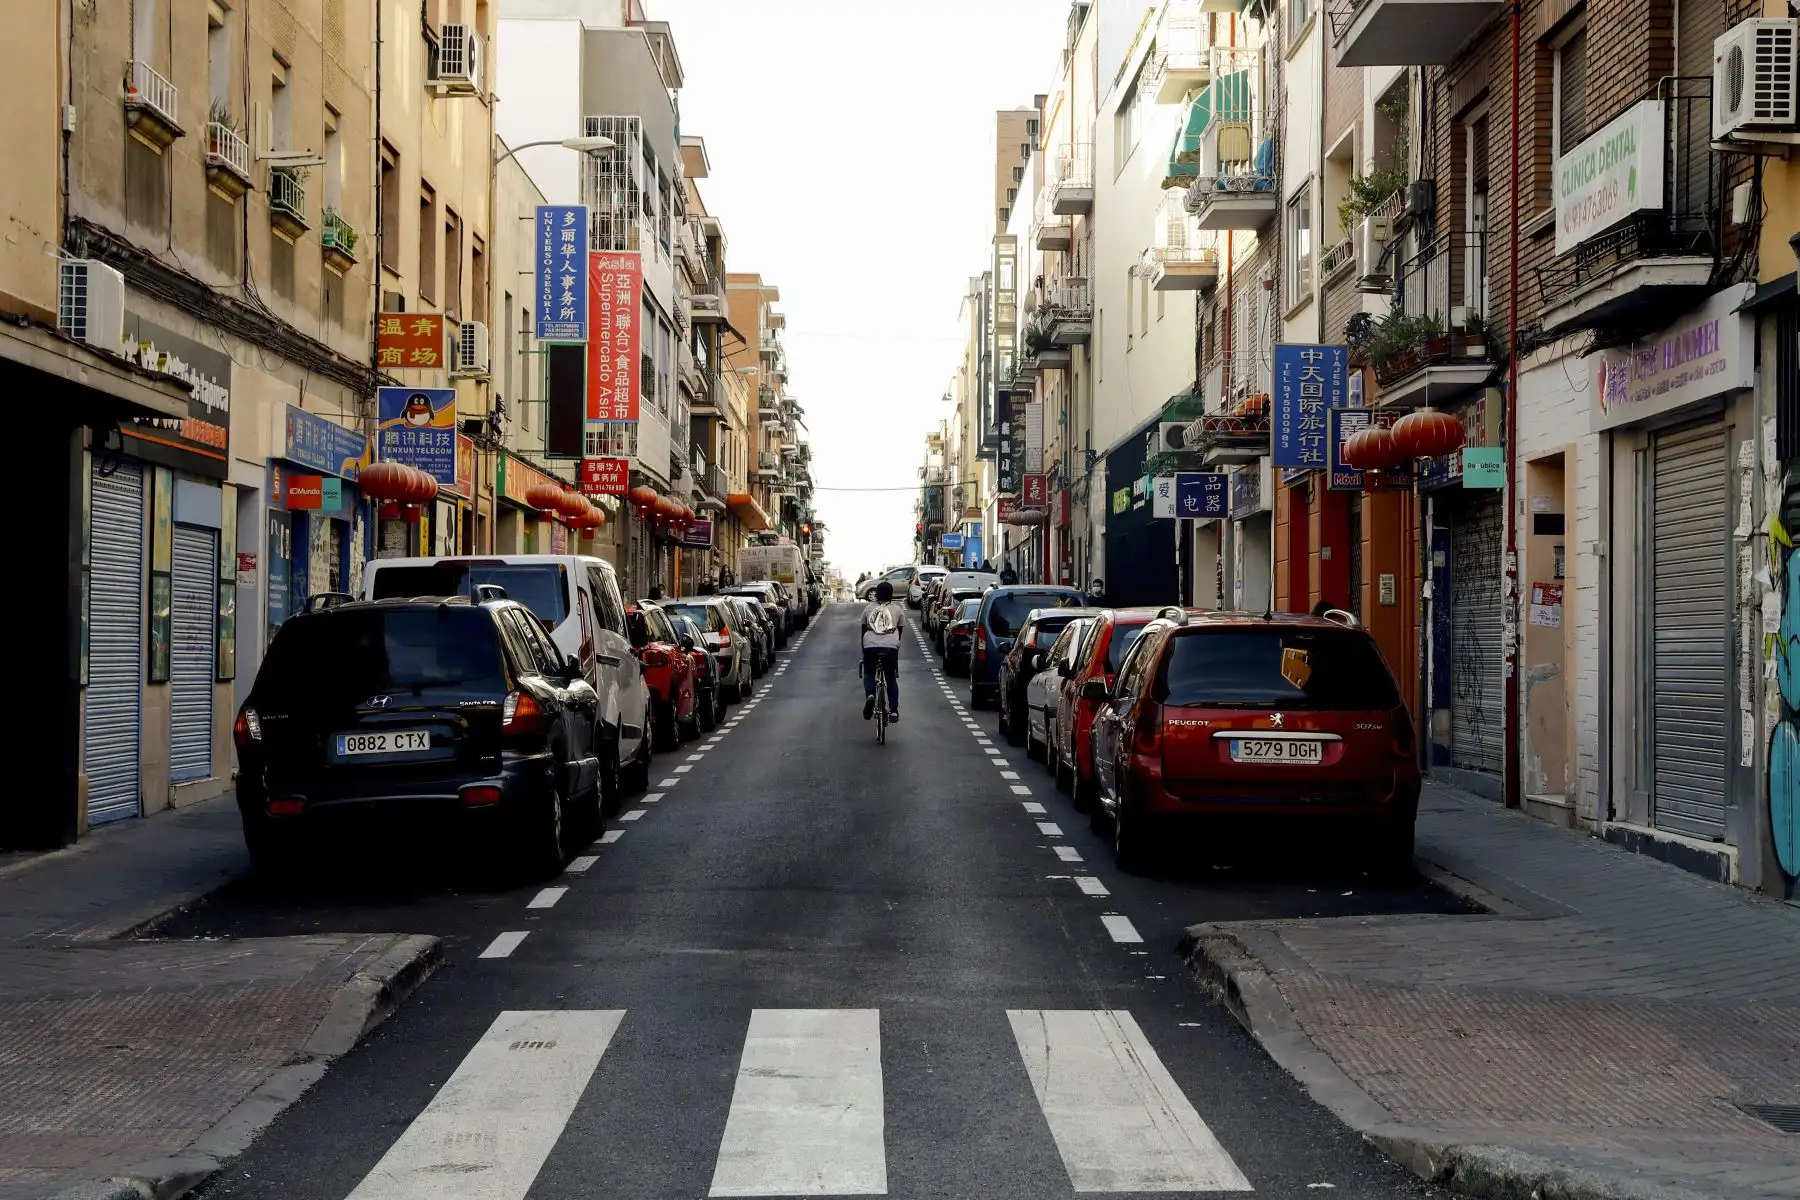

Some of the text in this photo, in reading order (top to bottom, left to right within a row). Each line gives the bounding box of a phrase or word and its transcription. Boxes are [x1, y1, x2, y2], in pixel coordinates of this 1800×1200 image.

[1598, 125, 1637, 175] DENTAL
[543, 212, 554, 321] UNIVERSO ASESORIA
[560, 211, 577, 322] 多丽华人事务所
[379, 318, 438, 337] 温青
[598, 273, 614, 419] Supermercado Asia
[378, 347, 438, 366] 商场
[1332, 349, 1341, 386] VIAJES
[1281, 362, 1292, 449] TEL 915000983
[1297, 348, 1325, 464] 中天国际旅行社
[384, 431, 450, 446] 腾讯科技
[415, 447, 452, 455] TELECOM
[1467, 462, 1500, 471] República
[1182, 476, 1222, 491] 一品
[1183, 494, 1222, 512] 电器
[1168, 719, 1210, 727] PEUGEOT
[346, 732, 427, 753] 0882 CTX
[1243, 741, 1318, 758] 5279 DGH
